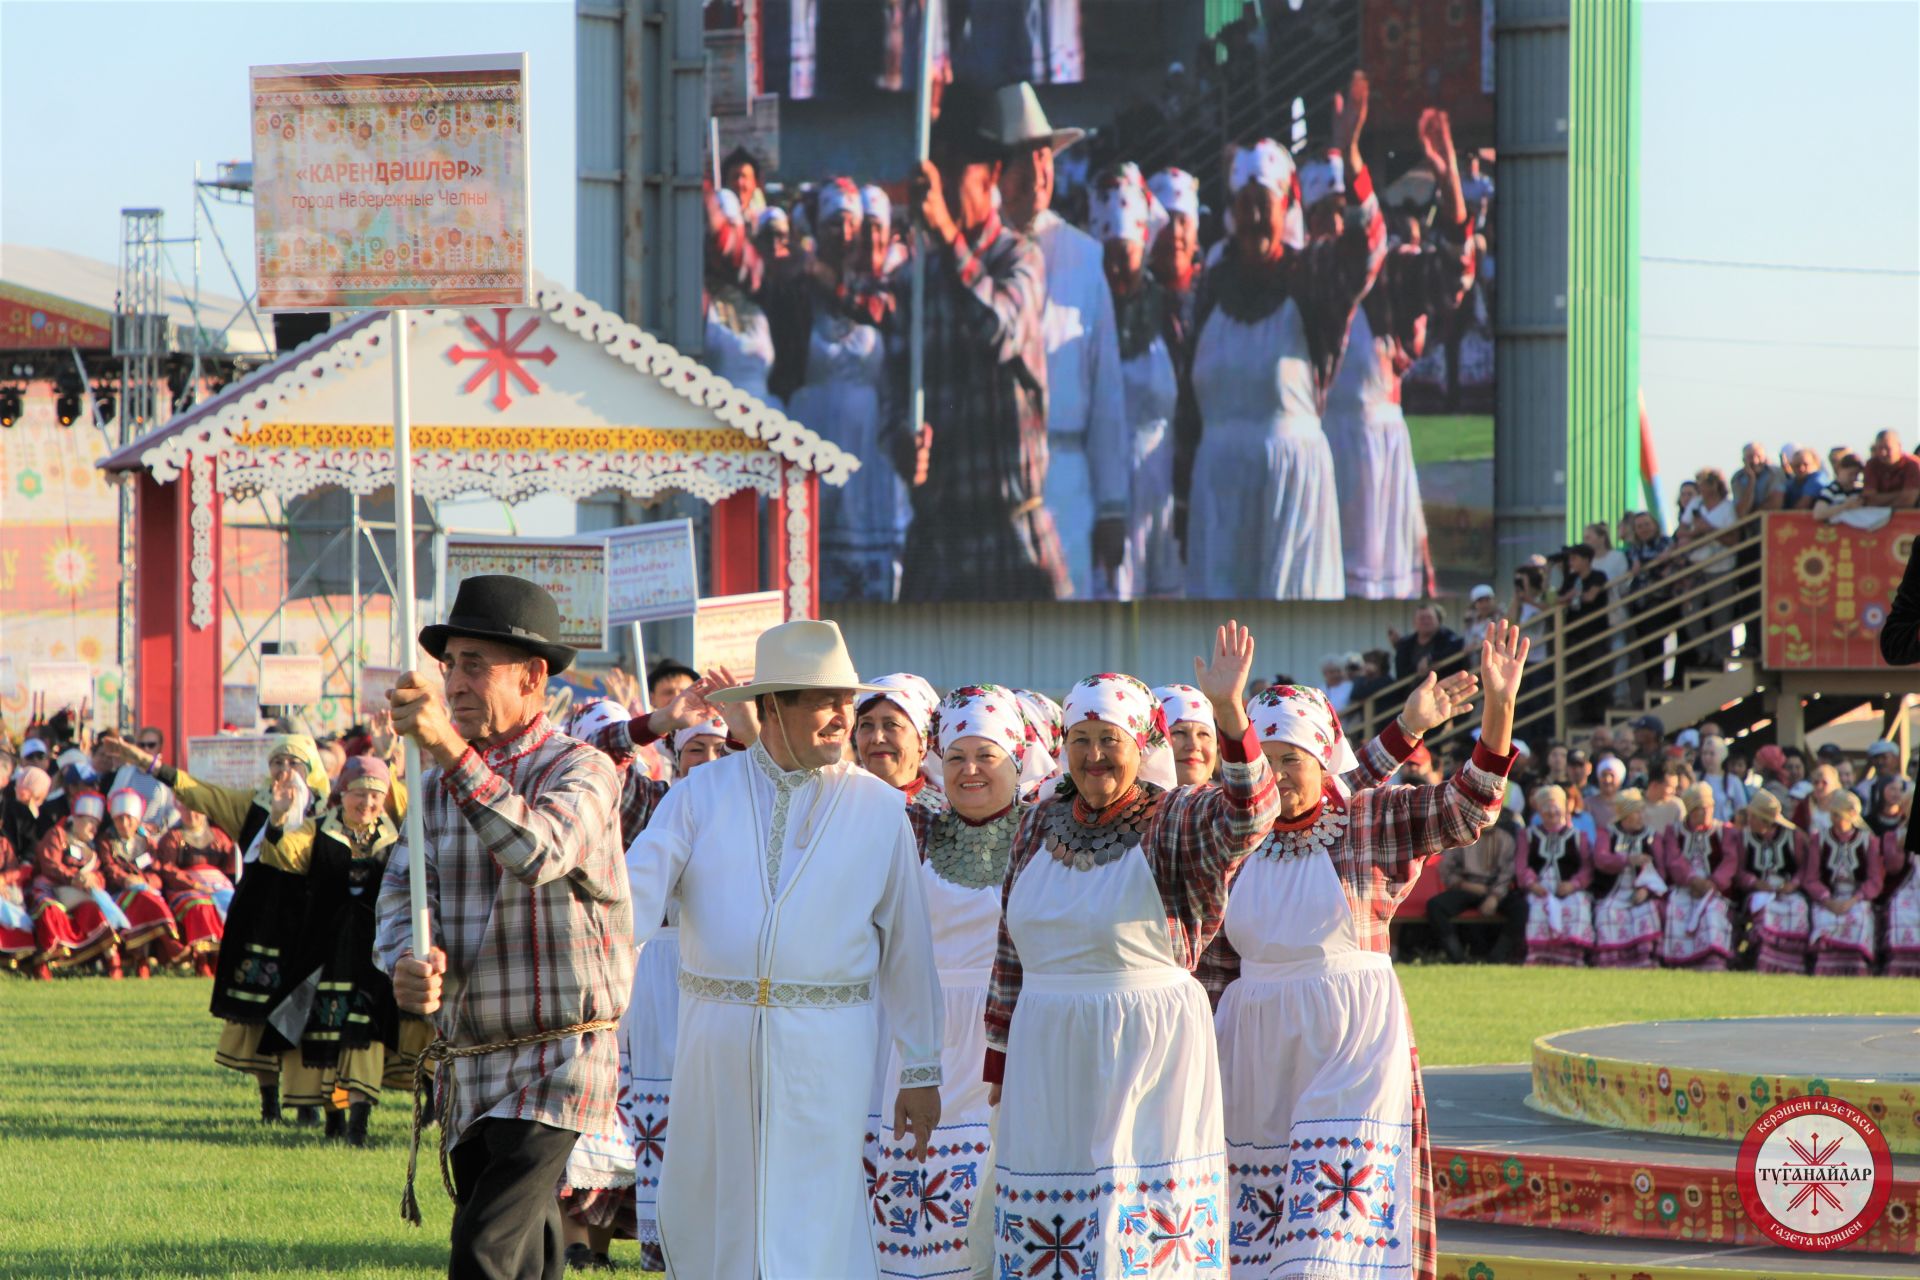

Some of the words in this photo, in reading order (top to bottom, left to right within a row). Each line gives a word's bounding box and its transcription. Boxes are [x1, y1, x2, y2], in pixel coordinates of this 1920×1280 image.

[292, 195, 333, 211] город
[339, 190, 434, 211] Набережные
[438, 189, 487, 206] Челны
